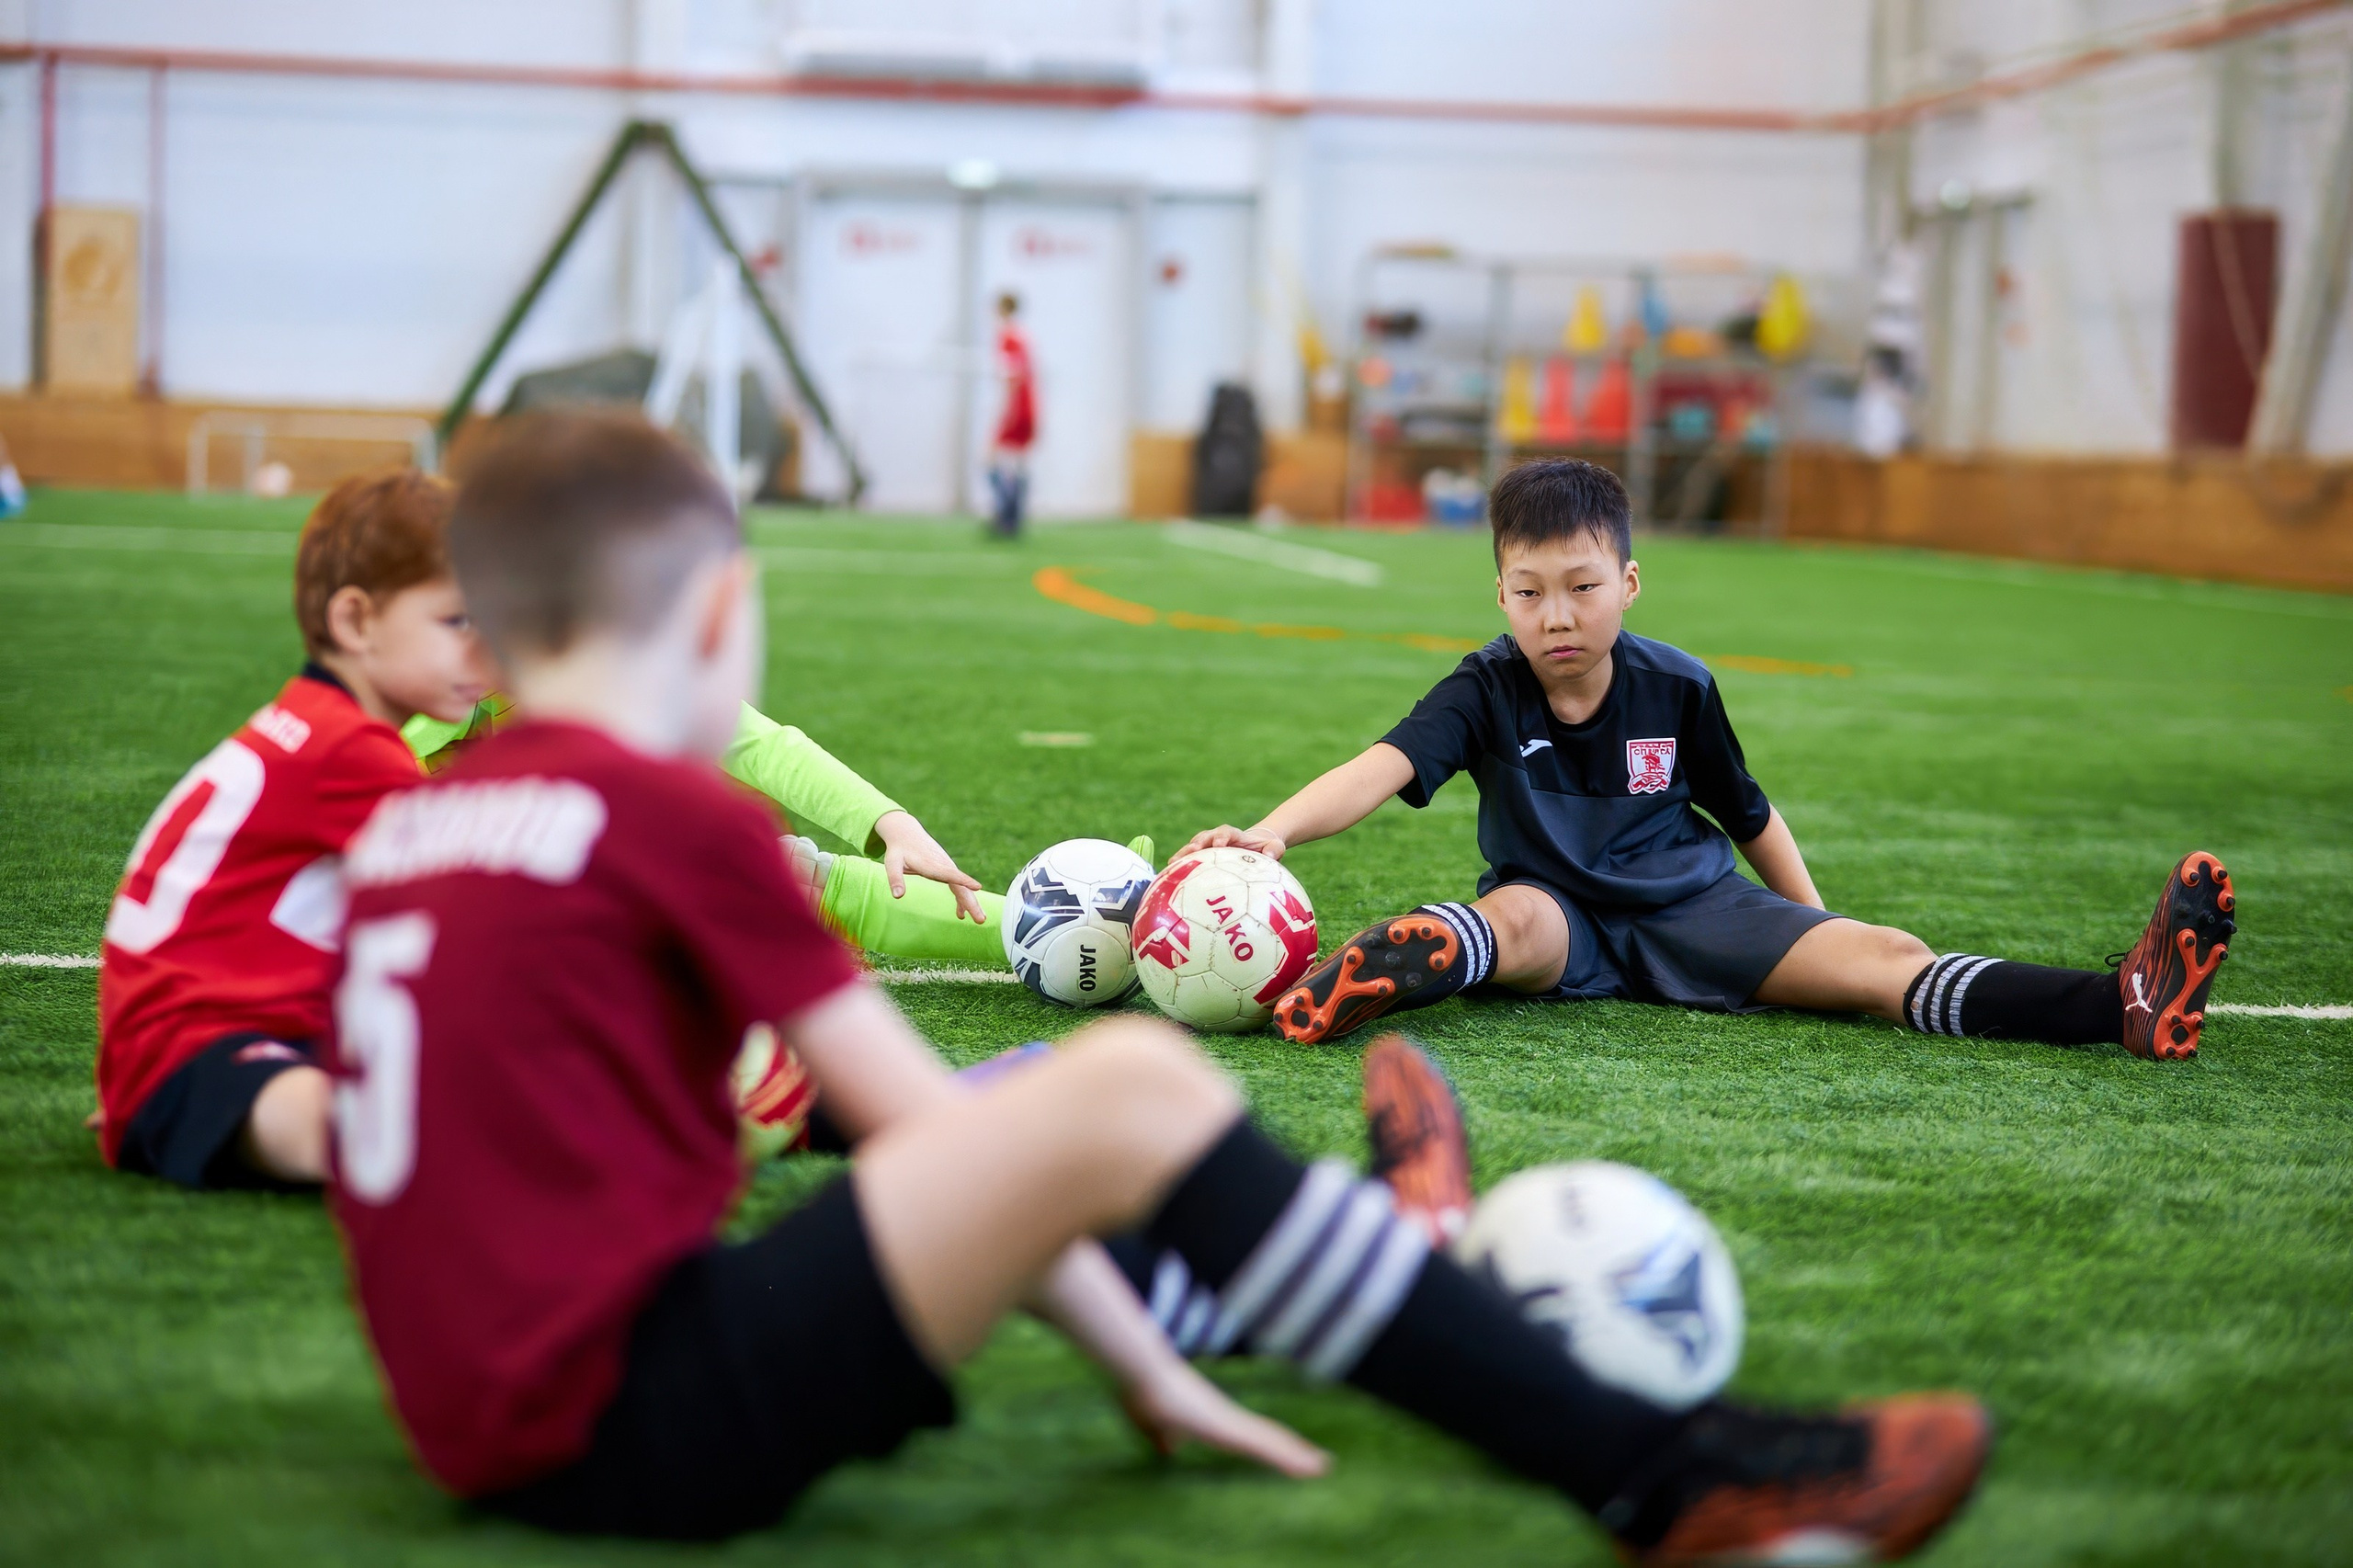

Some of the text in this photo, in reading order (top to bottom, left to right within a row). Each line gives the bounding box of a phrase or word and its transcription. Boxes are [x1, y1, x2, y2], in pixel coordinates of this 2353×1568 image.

[1206, 895, 1254, 961] JAKO
[1080, 944, 1097, 992] JAKO
[335, 912, 436, 1206] 5
